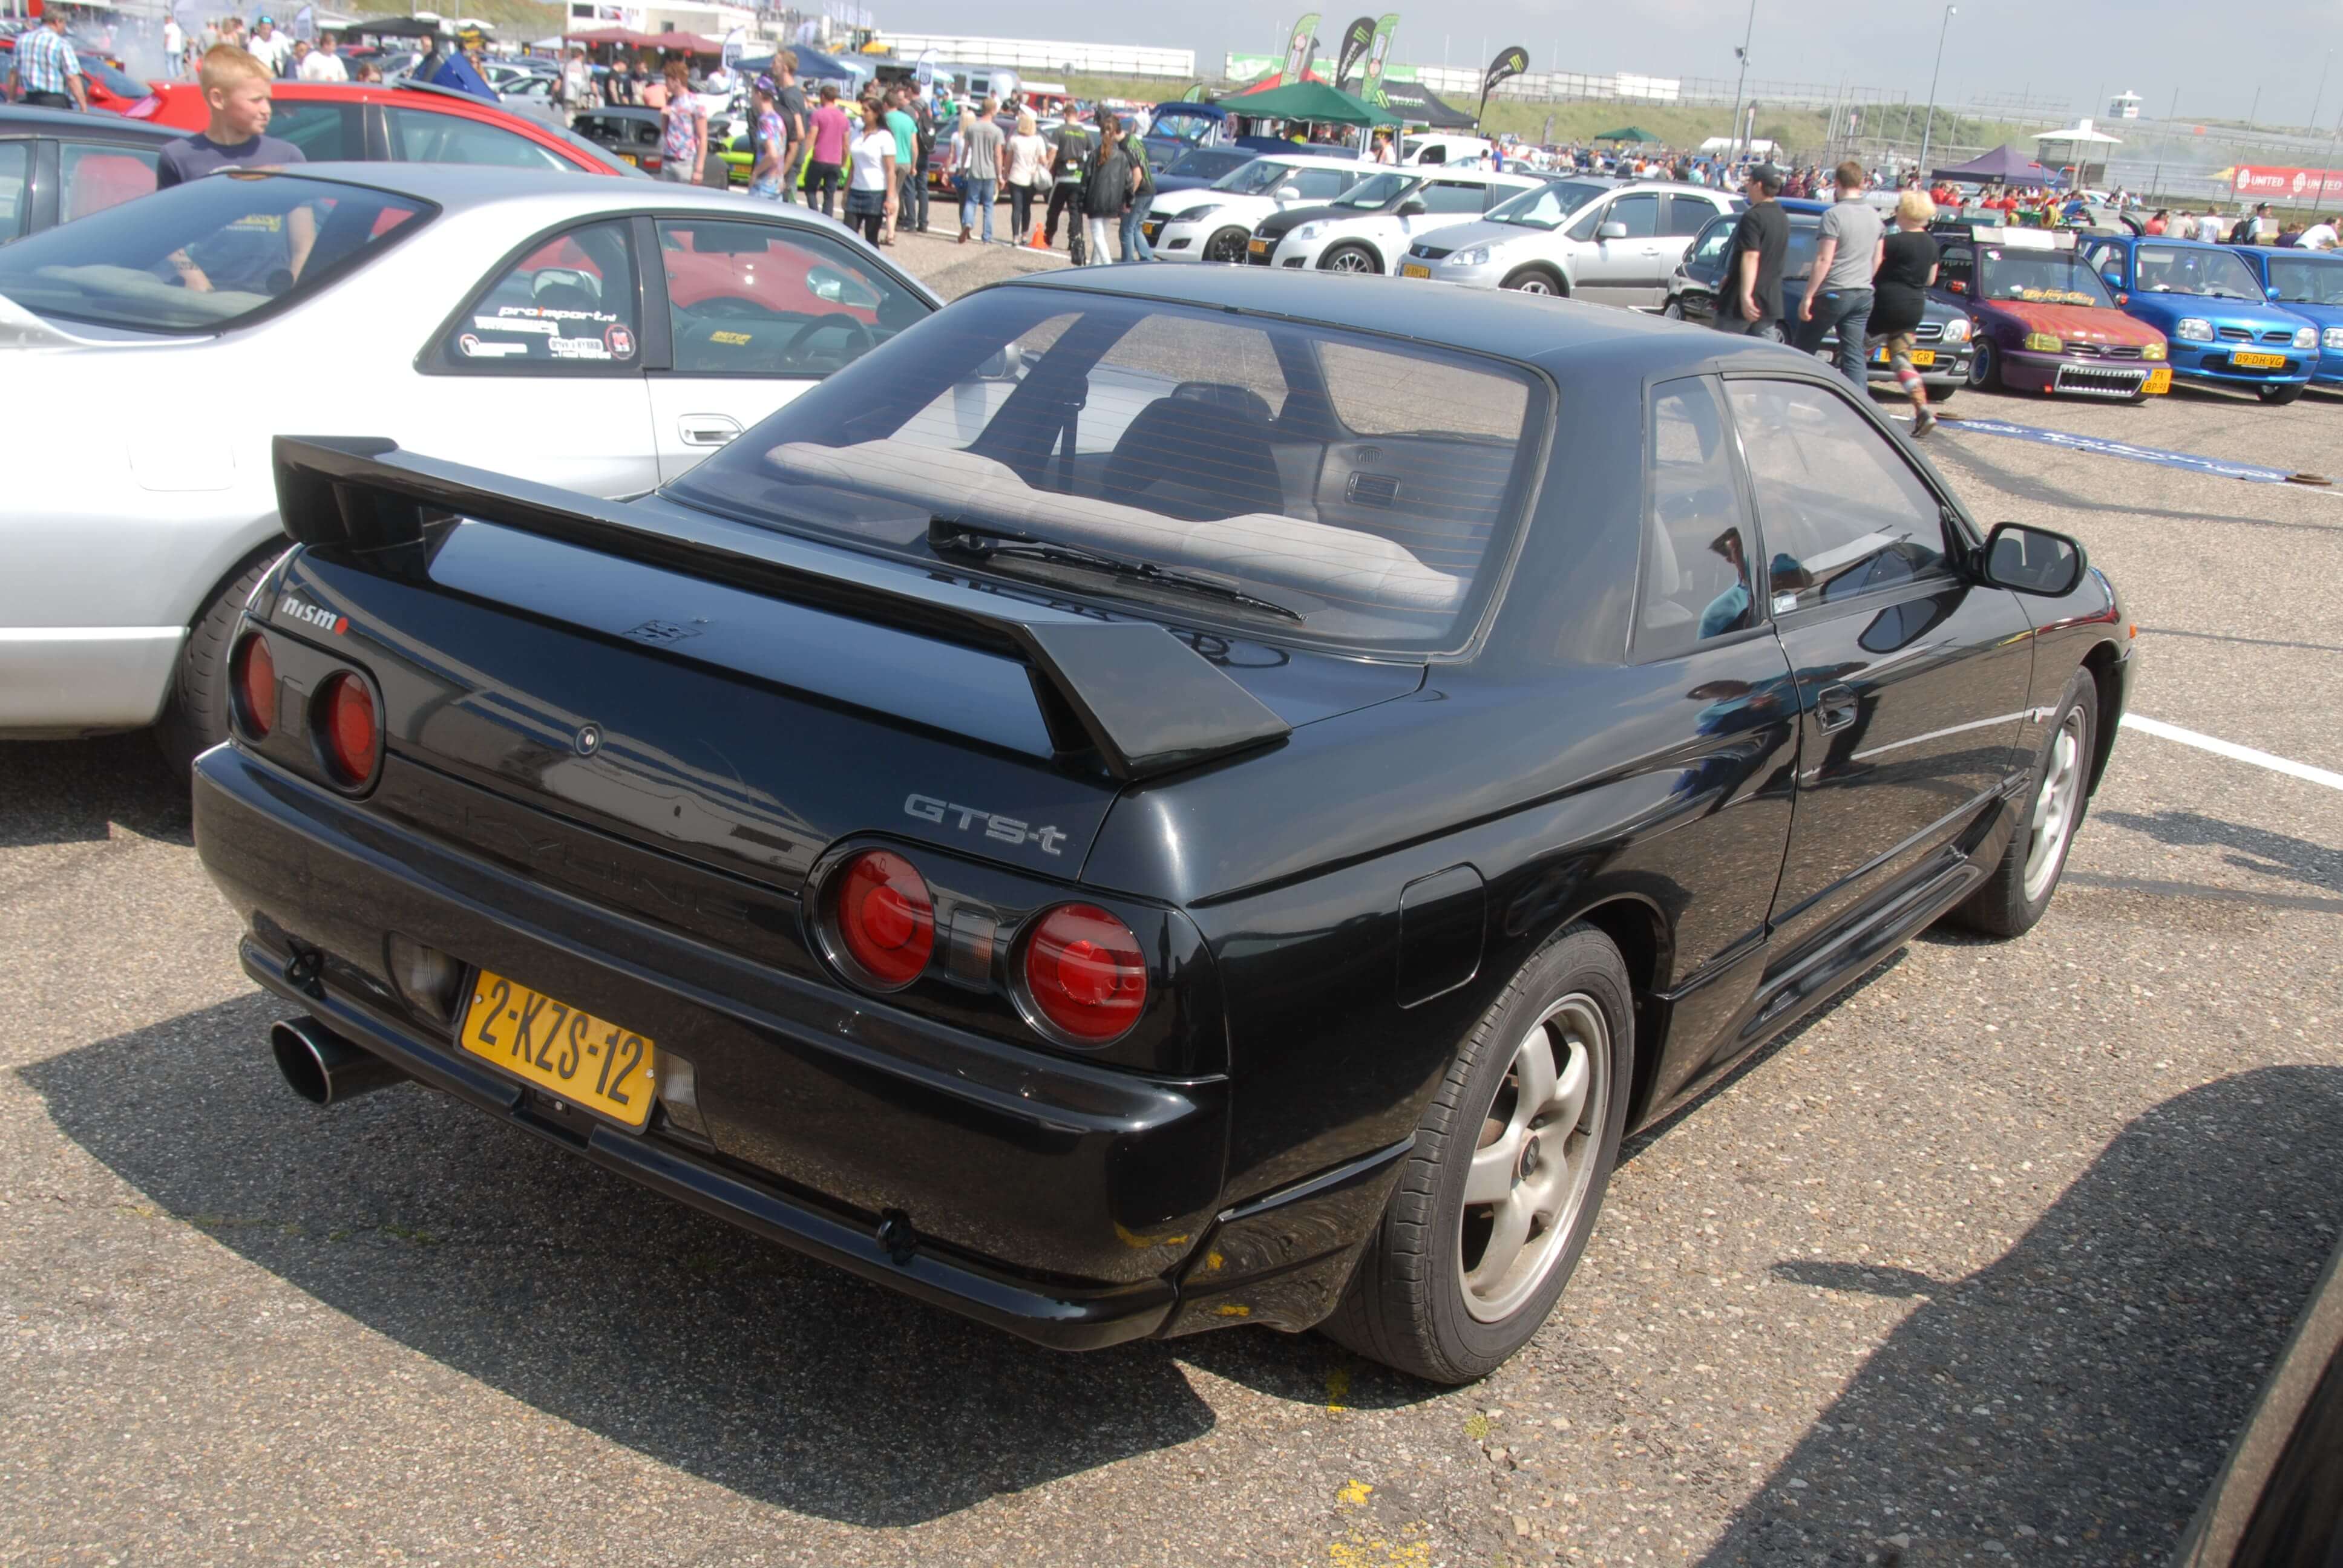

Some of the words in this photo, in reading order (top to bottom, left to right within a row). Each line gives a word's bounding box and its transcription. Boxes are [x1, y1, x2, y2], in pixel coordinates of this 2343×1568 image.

[2250, 175, 2284, 188] UNITED
[499, 306, 617, 322] proimport.nl
[2235, 353, 2283, 365] 09-DH-VG
[903, 793, 1067, 857] GTS-t
[477, 978, 644, 1105] 2-KZS-12
